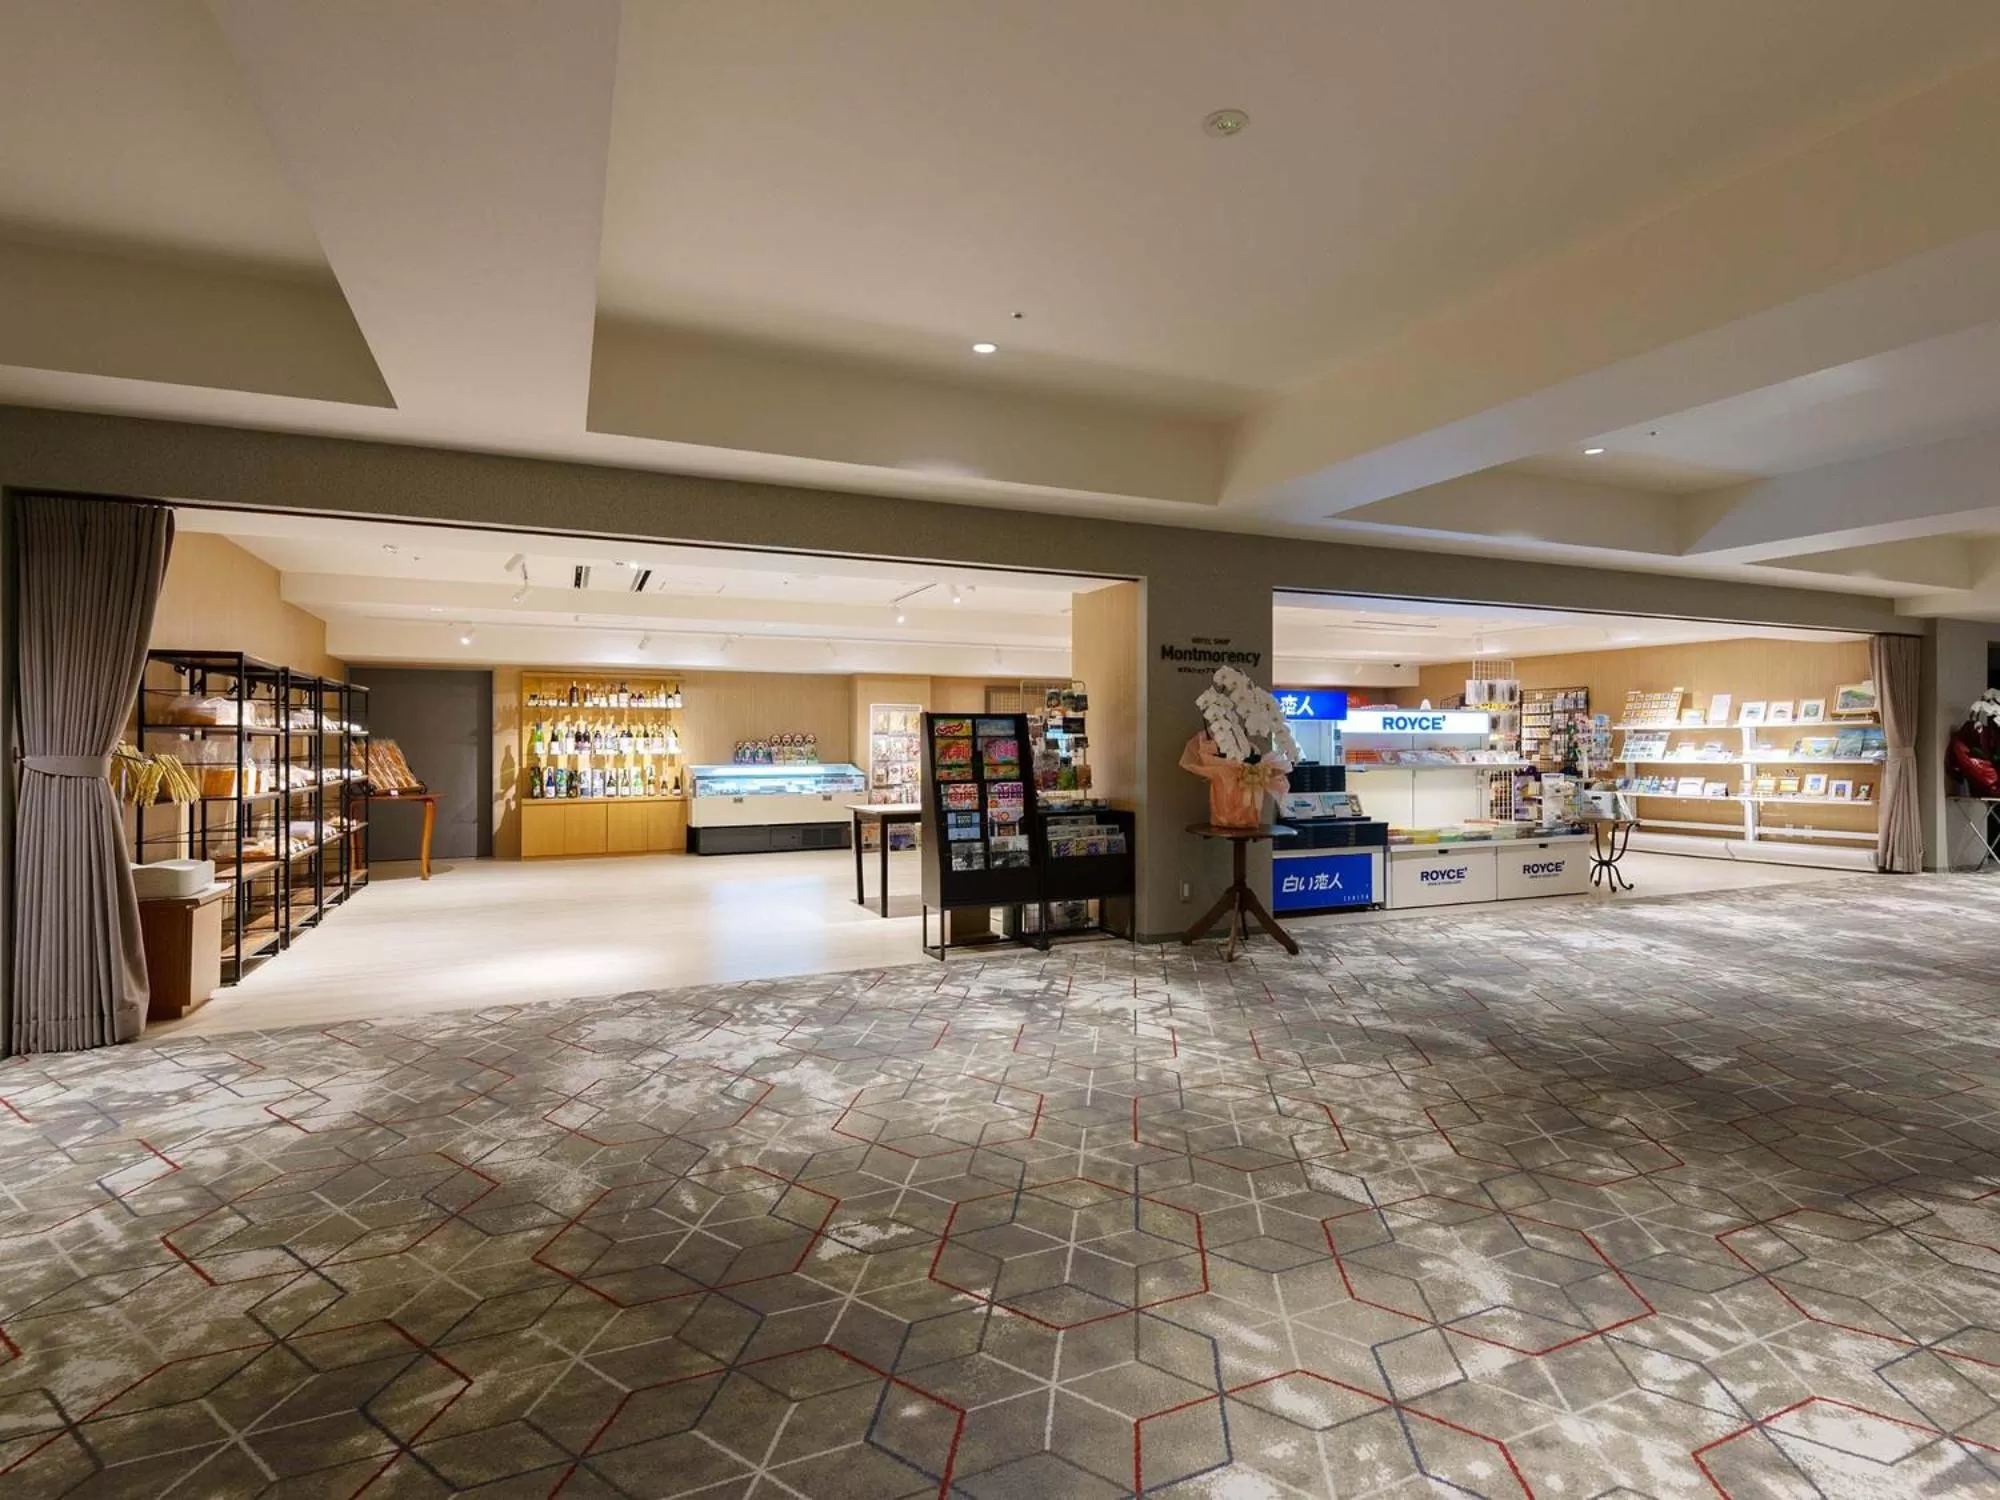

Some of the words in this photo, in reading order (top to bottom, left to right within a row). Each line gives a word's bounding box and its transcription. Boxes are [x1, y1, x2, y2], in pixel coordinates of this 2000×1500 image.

[1161, 644, 1261, 668] Montmorency
[1382, 715, 1447, 731] ROYCE'
[1420, 866, 1468, 881] ROYCE'
[1523, 860, 1565, 874] ROYCE'
[1282, 872, 1344, 893] 白い恋人
